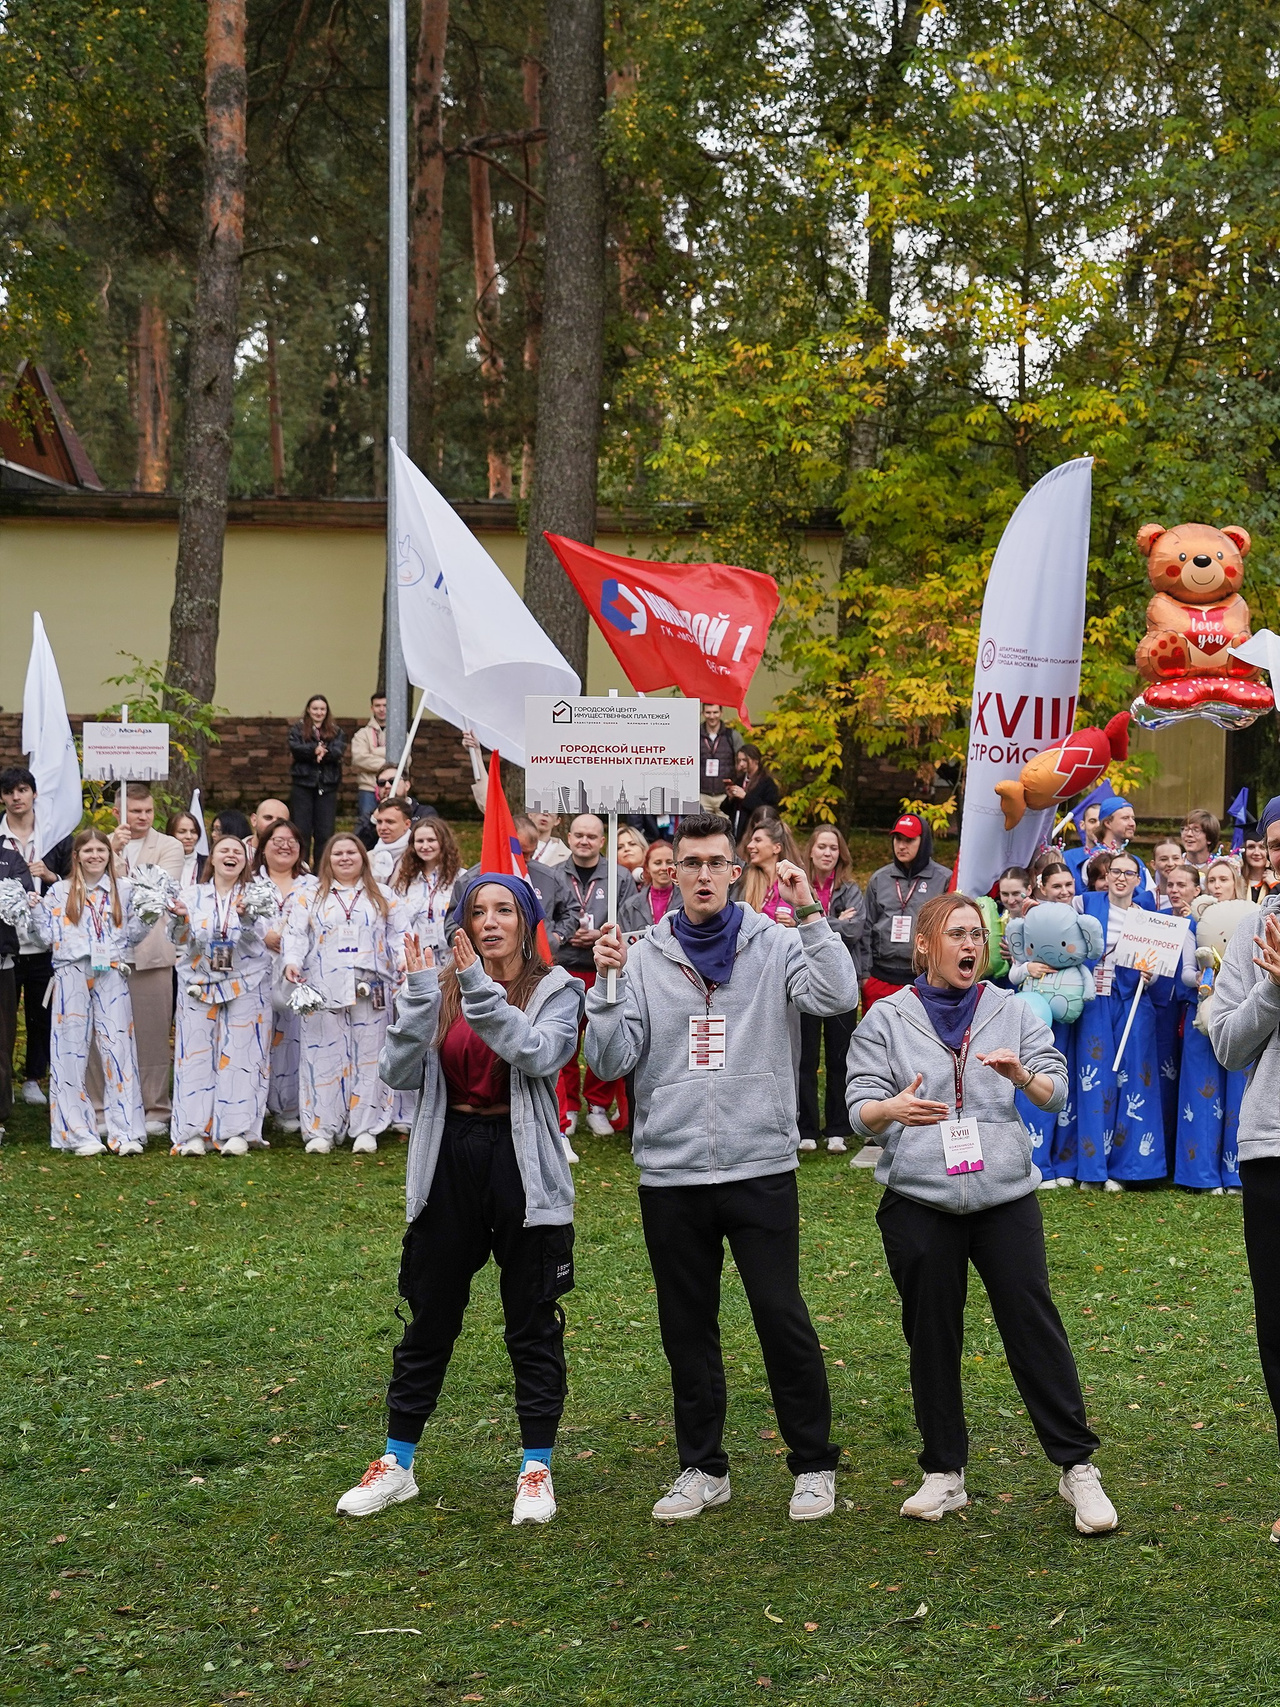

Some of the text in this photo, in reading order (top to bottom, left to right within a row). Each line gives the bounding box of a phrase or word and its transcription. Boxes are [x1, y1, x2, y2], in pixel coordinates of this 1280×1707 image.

[1201, 611, 1207, 621] I
[1191, 617, 1223, 632] love
[732, 624, 753, 663] 1
[1198, 633, 1227, 649] you
[973, 691, 1076, 740] XVIII
[560, 744, 666, 755] ГОРОДСКОЙ ЦЕНТР
[970, 742, 1039, 764] СТРОЙС
[531, 755, 694, 766] ИМУЩЕСТВЕННЫХ ПЛАТЕЖЕЙ
[1122, 933, 1180, 951] МОНАРХ-ПРОЕКТ
